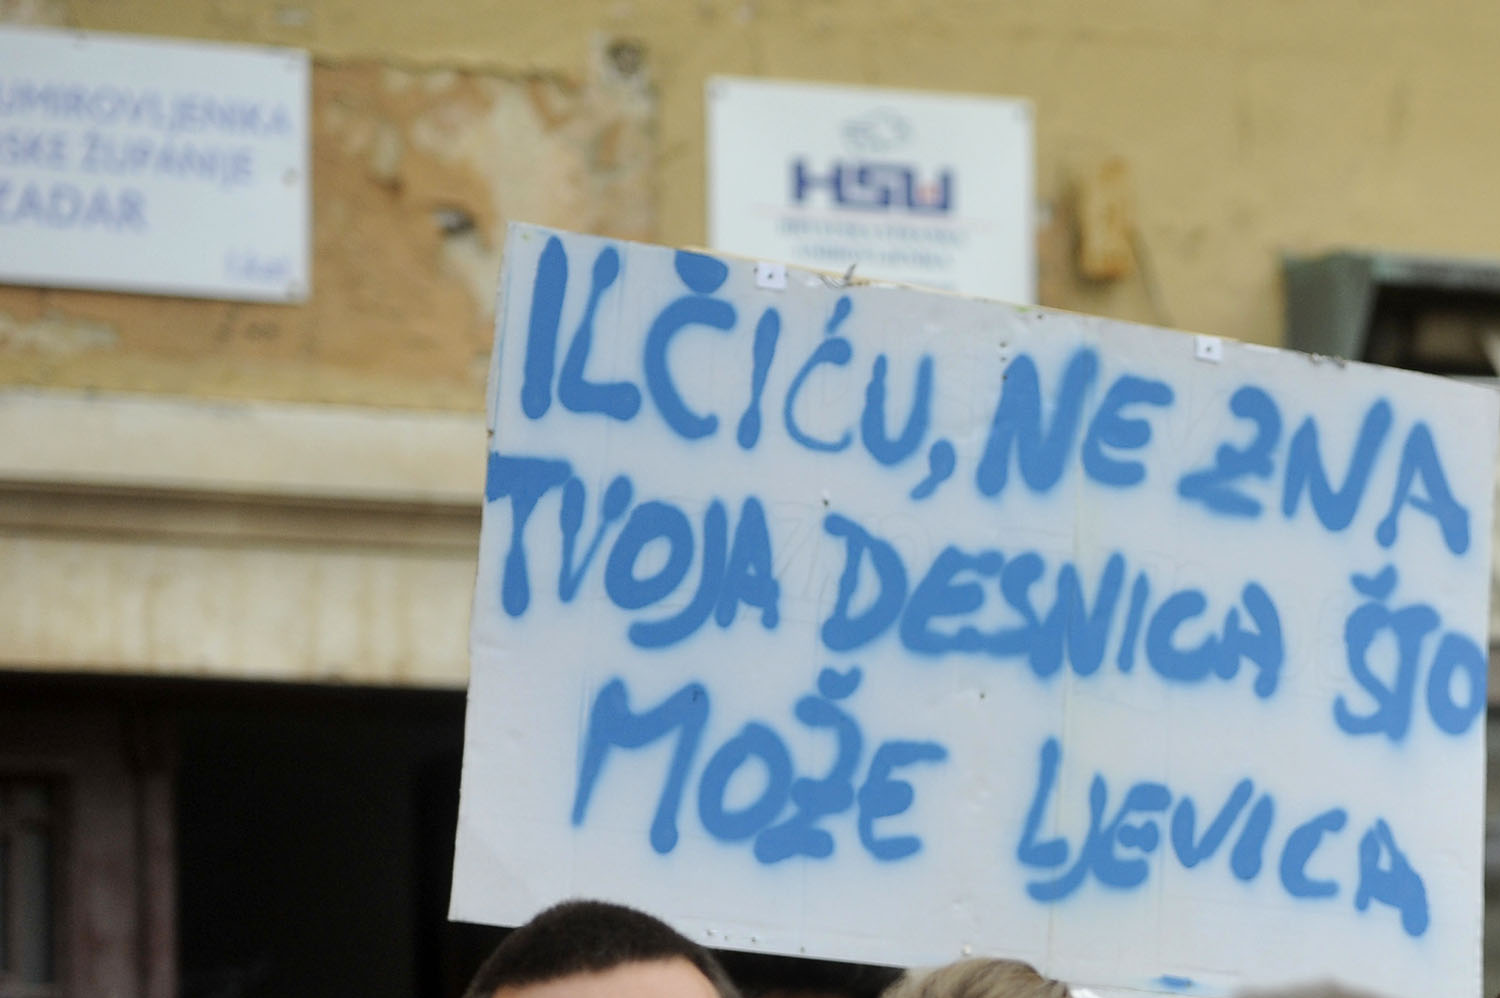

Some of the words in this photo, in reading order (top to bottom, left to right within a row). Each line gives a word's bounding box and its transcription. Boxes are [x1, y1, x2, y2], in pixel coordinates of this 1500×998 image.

[520, 235, 957, 500] ILČIĆU,
[976, 347, 1175, 497] NE
[1177, 384, 1470, 556] ZNA
[486, 451, 780, 649] TVOJA
[821, 512, 1284, 700] DESNICA
[1333, 565, 1488, 742] ŠTO
[571, 666, 949, 865] MOŽE
[1016, 737, 1430, 938] LJEVICA
